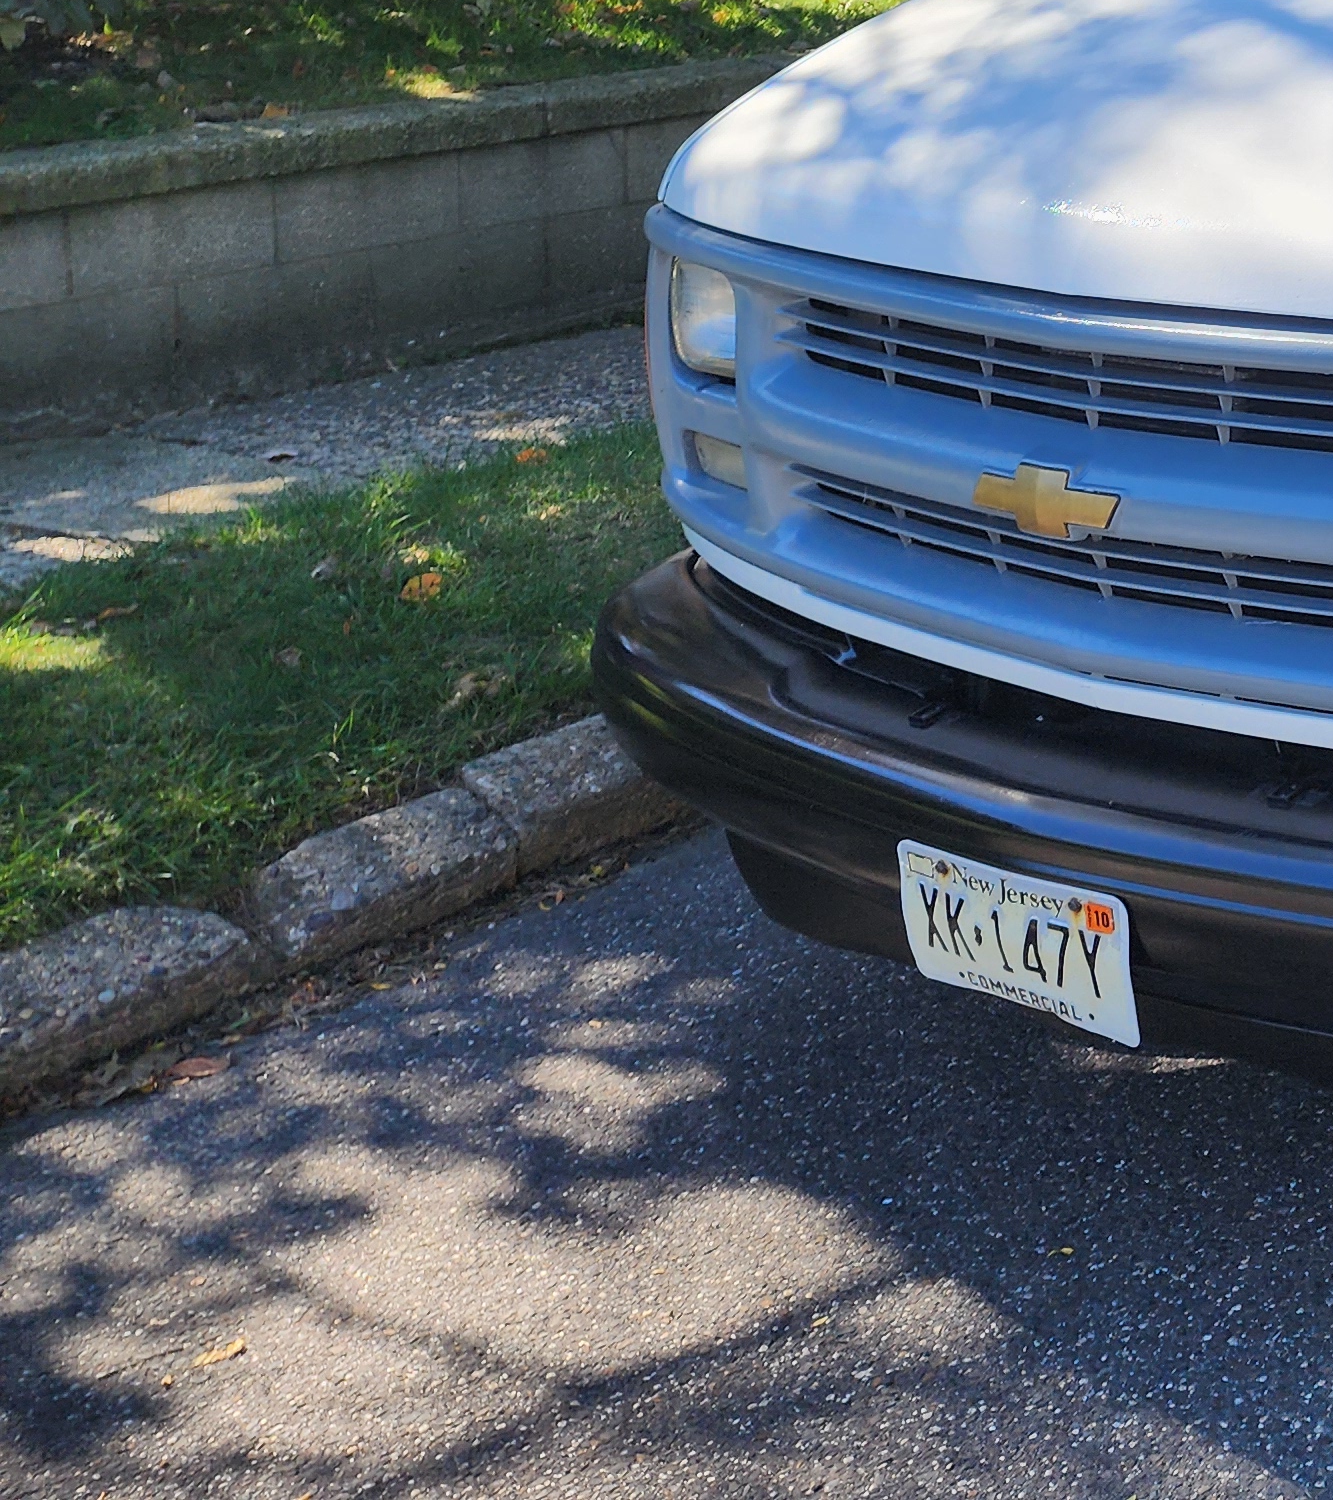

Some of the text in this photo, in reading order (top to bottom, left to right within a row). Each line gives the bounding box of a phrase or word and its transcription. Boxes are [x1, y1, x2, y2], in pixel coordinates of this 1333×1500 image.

[950, 862, 995, 896] New
[997, 878, 1064, 918] Jersey
[1094, 910, 1109, 928] 10
[966, 970, 1083, 1022] COMMERCIAL
